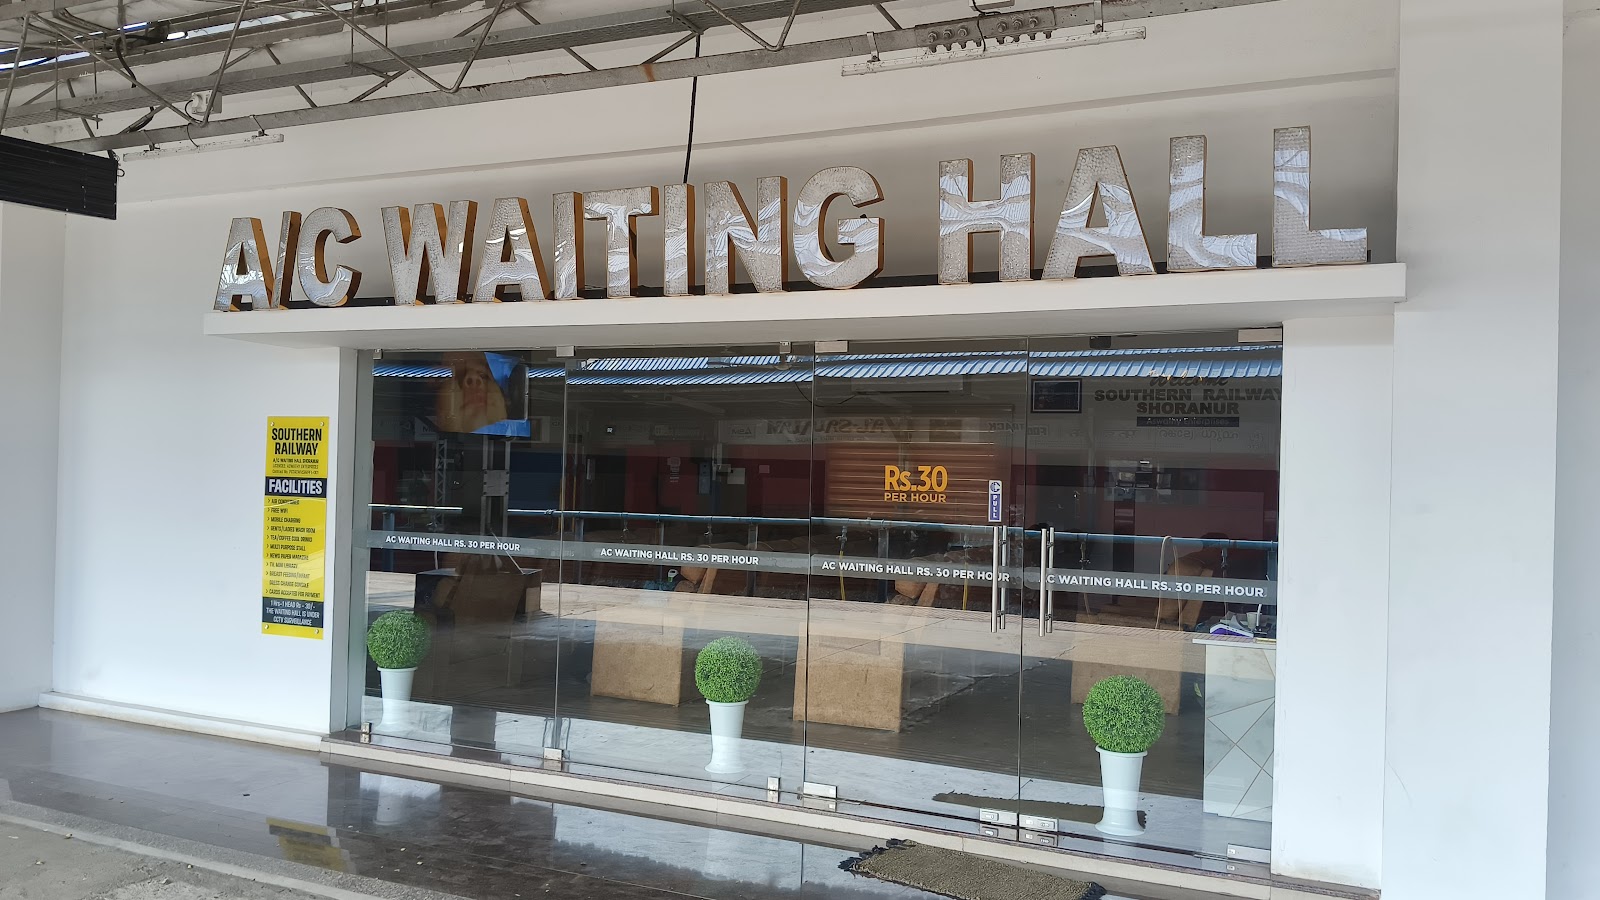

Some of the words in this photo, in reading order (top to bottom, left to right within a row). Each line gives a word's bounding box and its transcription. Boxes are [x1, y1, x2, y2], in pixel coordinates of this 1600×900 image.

[212, 206, 362, 312] A/C
[380, 165, 885, 306] WAITING
[937, 125, 1369, 284] HALL
[1094, 388, 1192, 401] SOUTHERN
[1136, 402, 1240, 415] SHORANUR
[1183, 417, 1230, 426] Enterprises
[271, 428, 322, 441] SOUTHERN
[274, 442, 319, 456] RAILWAY
[884, 465, 948, 492] Rs.30
[268, 479, 323, 495] FACILITIES
[884, 492, 908, 502] PER
[911, 493, 947, 503] HOUR
[385, 535, 397, 543] AC
[398, 536, 431, 545] WAITING
[432, 538, 453, 547] HALL
[454, 540, 466, 548] RS.
[468, 540, 478, 549] 30
[479, 541, 496, 550] PER
[497, 542, 521, 551] HOUR
[600, 548, 613, 557] AC
[614, 549, 653, 559] WAITING
[654, 551, 679, 561] HALL
[680, 553, 695, 562] RS.
[696, 553, 709, 562] 30
[711, 554, 729, 564] PER
[731, 555, 759, 565] HOUR
[821, 561, 836, 570] AC
[838, 562, 884, 573] WAITING
[886, 564, 914, 575] HALL
[916, 567, 934, 577] RS.
[936, 568, 950, 578] 30
[952, 569, 974, 579] PER
[1058, 575, 1112, 587] WAITING
[1115, 578, 1149, 590] HALL
[1151, 580, 1172, 591] RS.
[1175, 582, 1192, 593] 30
[1195, 583, 1221, 595] PER
[1225, 585, 1265, 598] HOUR
